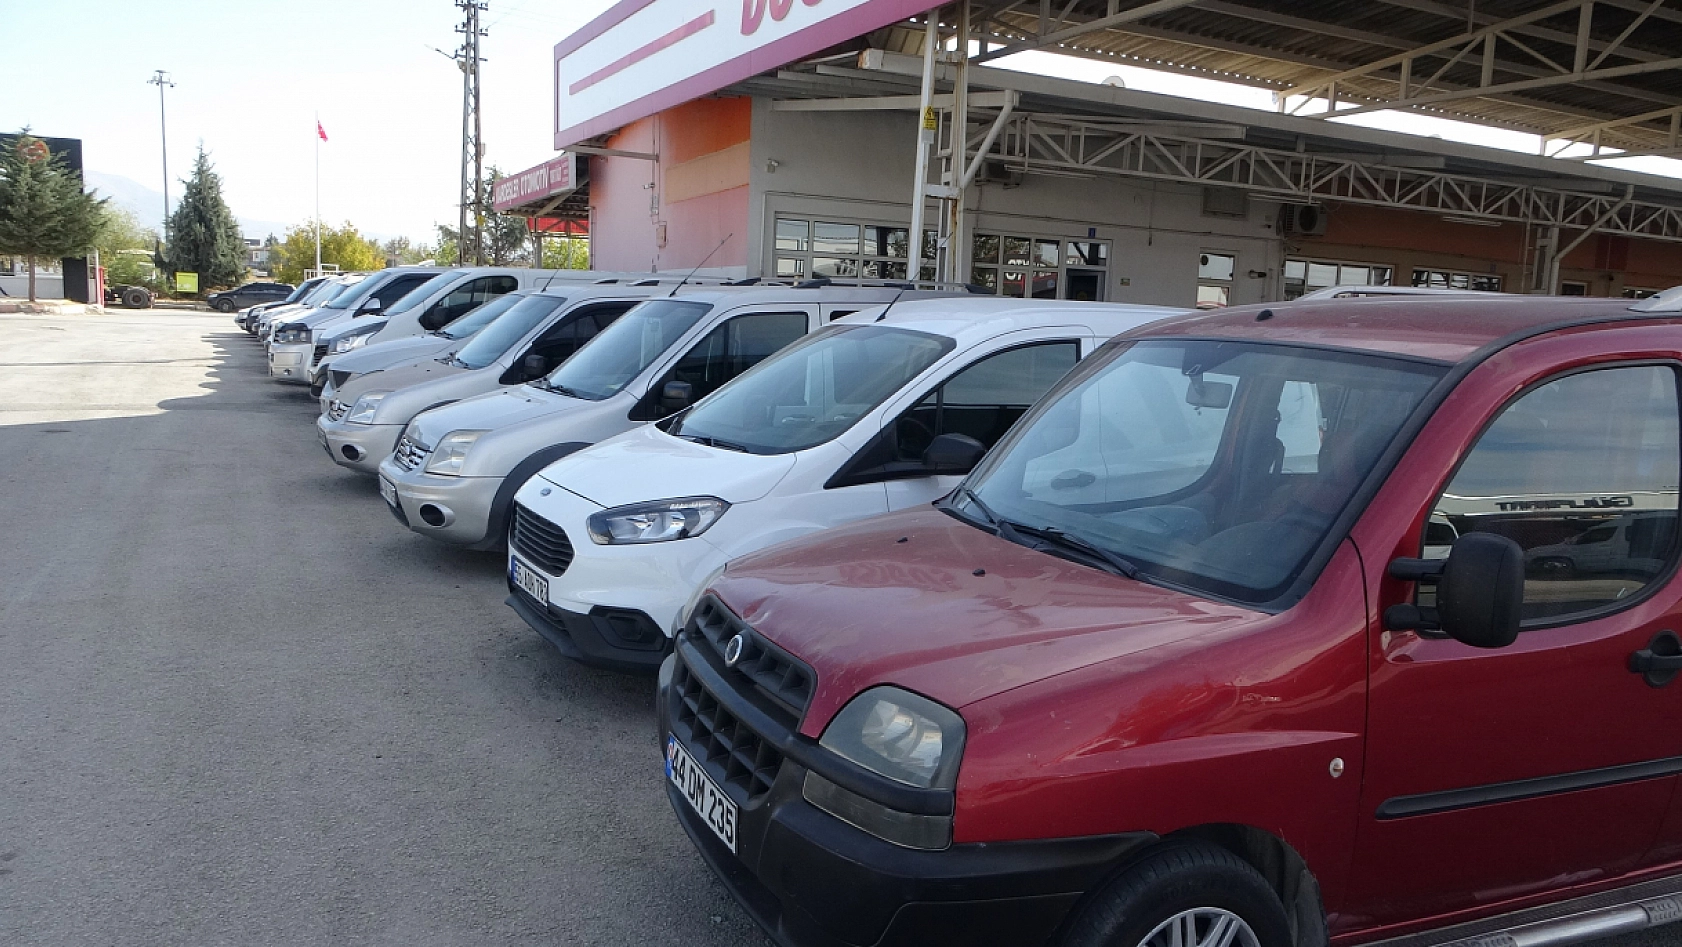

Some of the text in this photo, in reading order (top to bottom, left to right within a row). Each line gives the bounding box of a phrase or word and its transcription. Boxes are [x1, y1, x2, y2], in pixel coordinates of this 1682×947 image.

[672, 747, 734, 845] 44 DM 235
